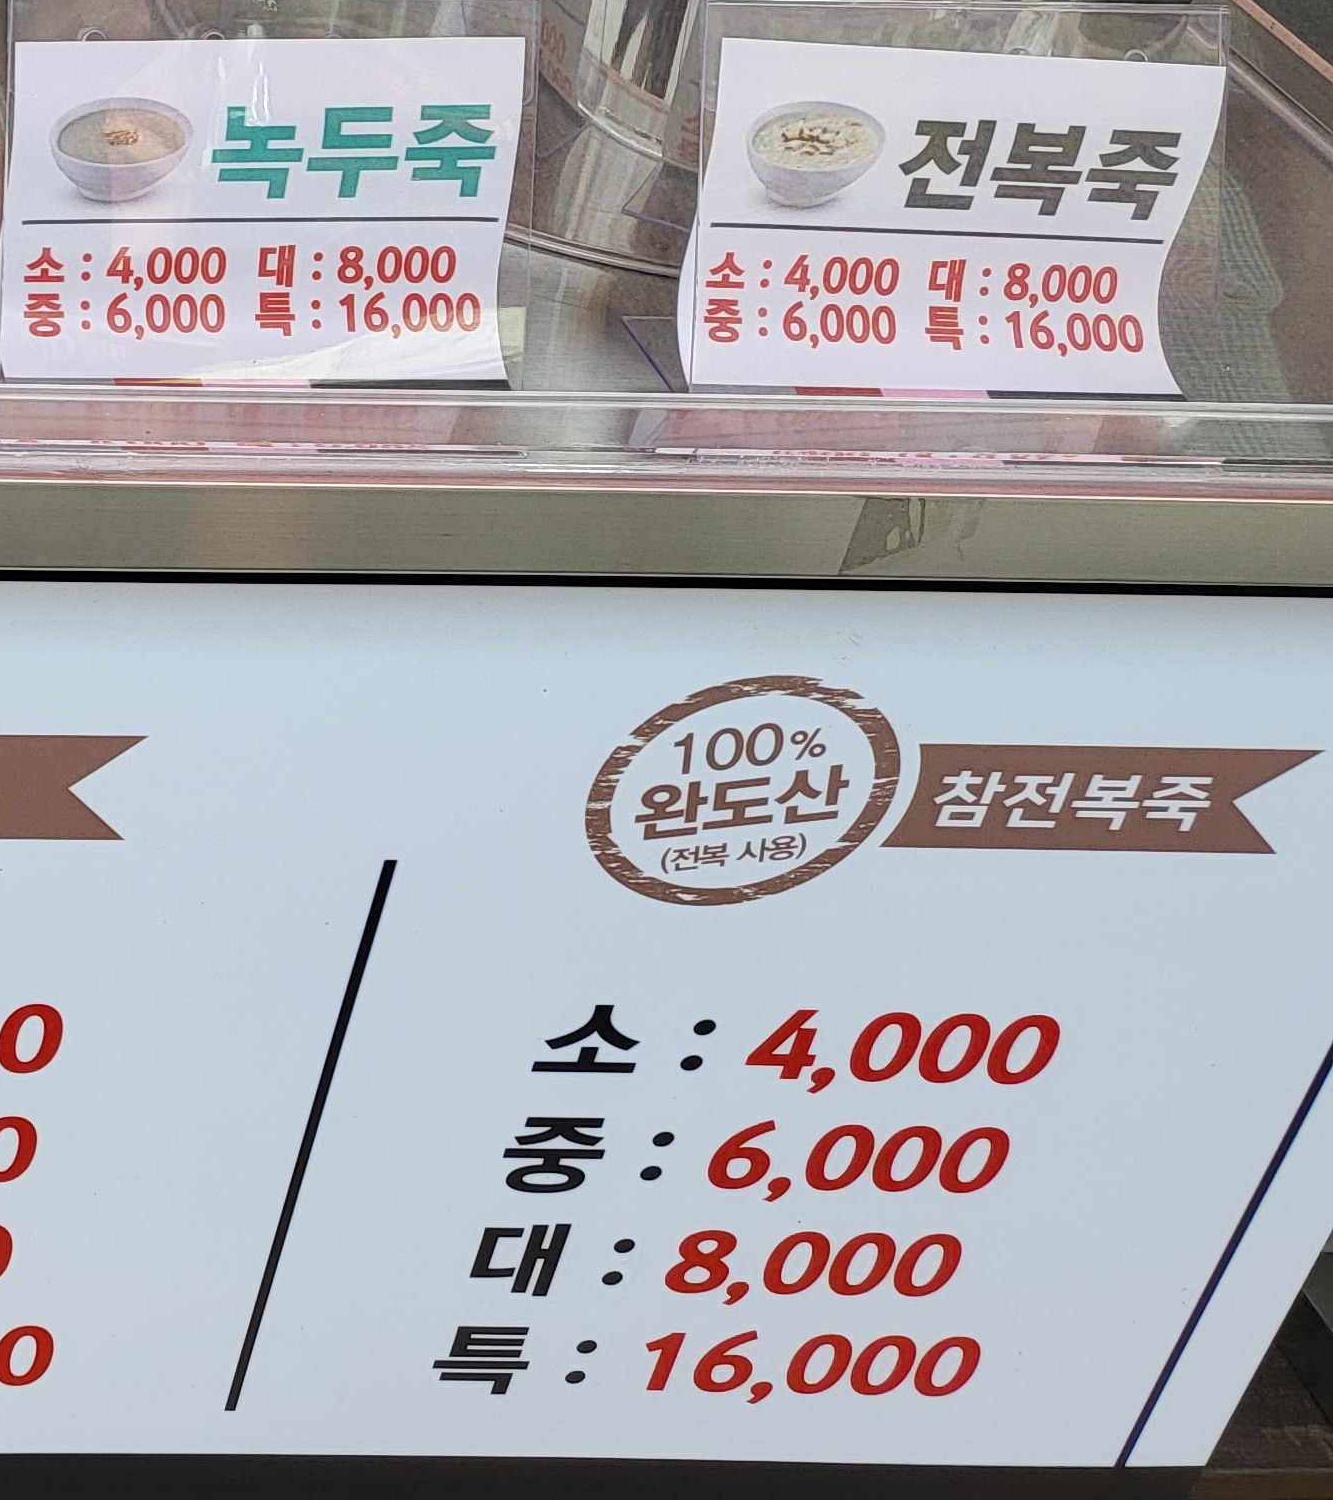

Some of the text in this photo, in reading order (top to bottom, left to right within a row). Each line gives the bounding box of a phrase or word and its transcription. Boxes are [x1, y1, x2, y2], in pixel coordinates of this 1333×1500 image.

[211, 105, 497, 199] 녹두죽
[898, 120, 1182, 220] 전복죽
[24, 247, 65, 283] 소
[106, 247, 227, 291] 4,000
[258, 245, 295, 288] 대
[337, 246, 456, 290] 8,000
[705, 252, 745, 289] 소
[784, 254, 900, 300] 4,000
[928, 259, 966, 302] 대
[1004, 263, 1118, 308] 8,000
[24, 293, 64, 338] 중
[106, 292, 225, 340] 6,000
[255, 292, 295, 336] 특
[339, 292, 480, 337] 16,000
[703, 298, 742, 343] 중
[783, 301, 897, 348] 6,000
[925, 306, 964, 350] 특
[1005, 310, 1144, 357] 16,000
[674, 723, 826, 779] 100%
[634, 760, 855, 844] 완도산
[934, 771, 1213, 831] 참전복죽
[661, 833, 806, 874] (전복 사용)
[531, 1005, 640, 1073] 소
[745, 1010, 1060, 1094] 4,000
[503, 1117, 605, 1193] 중
[708, 1120, 1010, 1202] 6,000
[470, 1224, 572, 1296] 대
[665, 1230, 962, 1305] 8,000
[432, 1326, 529, 1395] 특
[646, 1330, 981, 1404] 16,000
